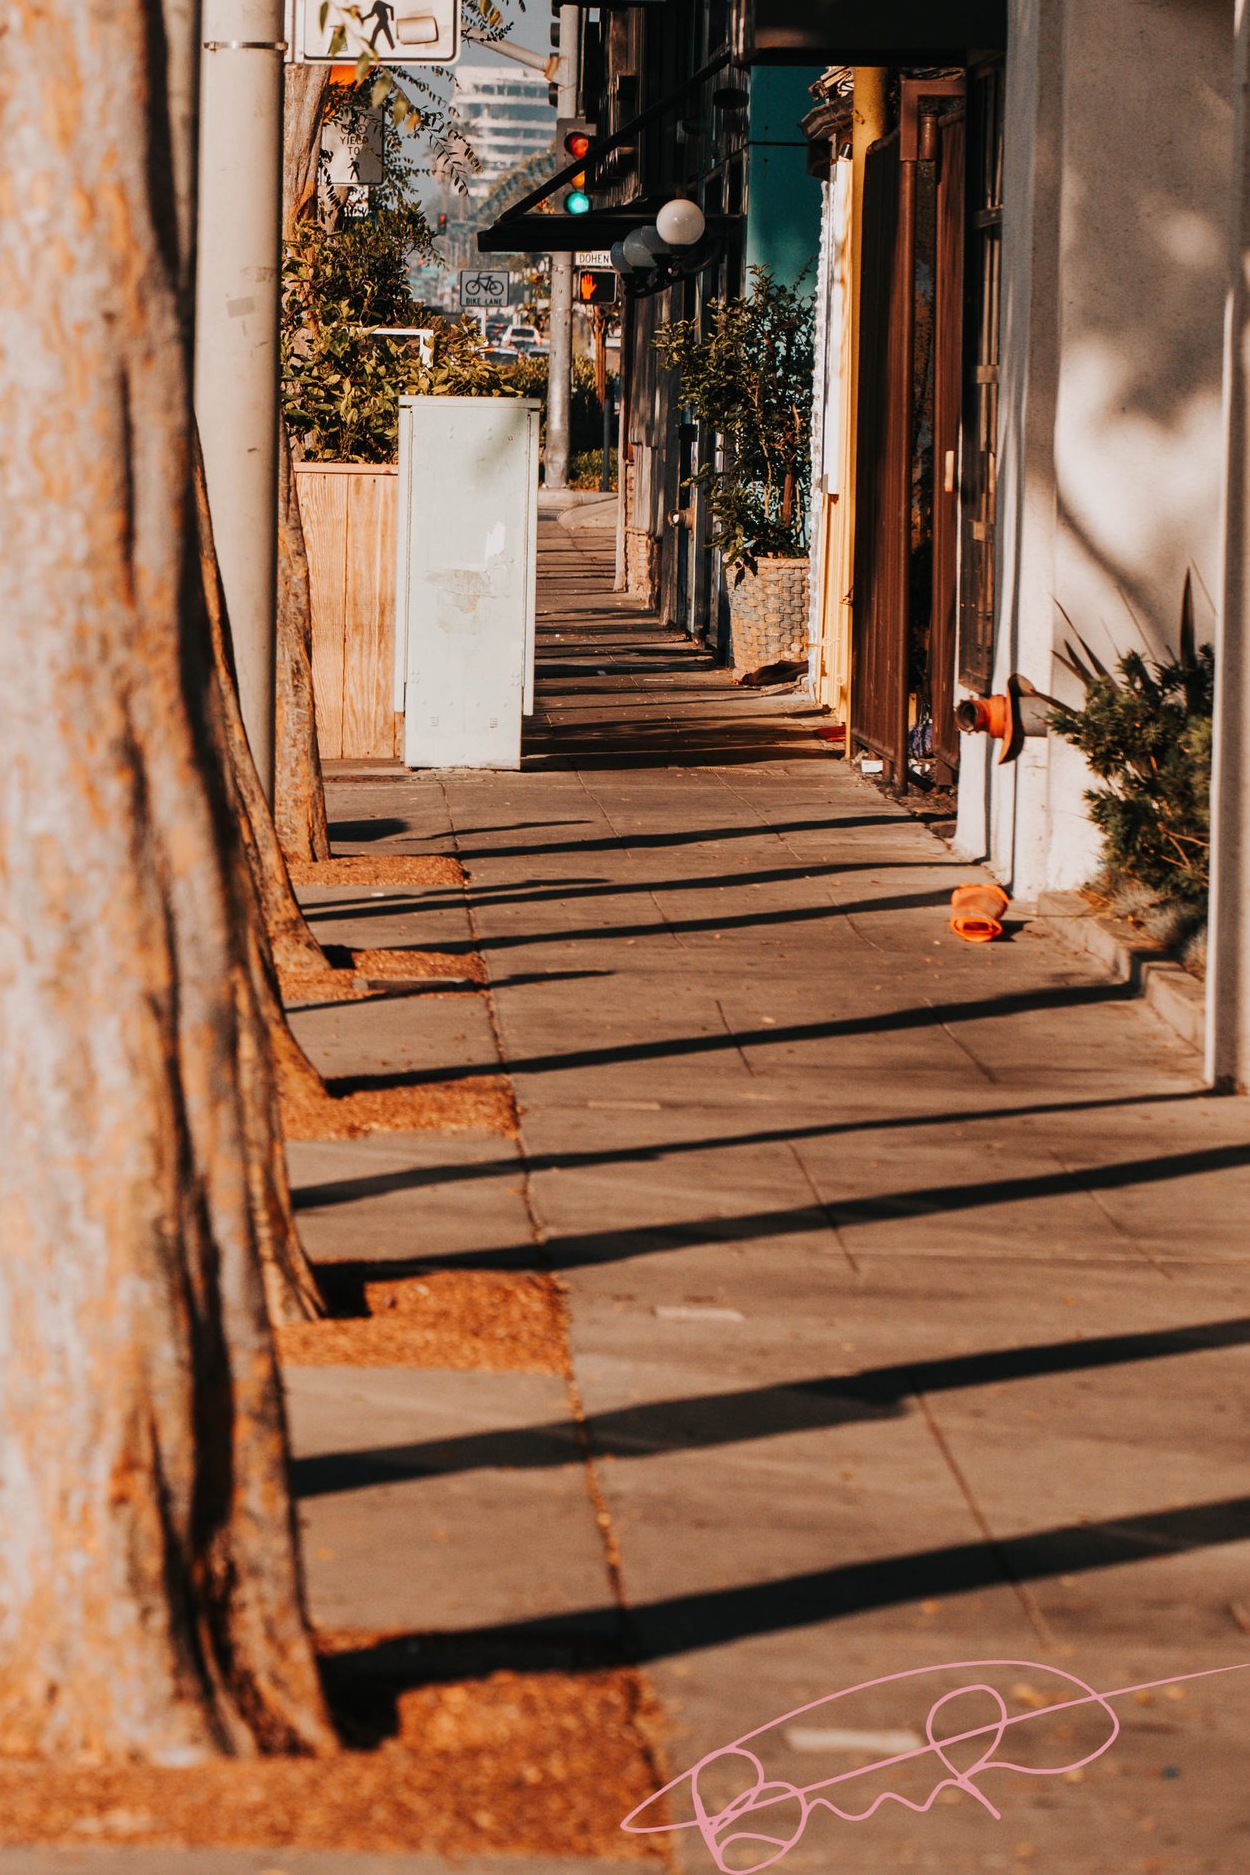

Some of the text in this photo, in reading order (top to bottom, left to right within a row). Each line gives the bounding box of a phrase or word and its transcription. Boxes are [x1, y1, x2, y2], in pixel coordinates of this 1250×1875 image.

[348, 146, 361, 156] TO
[579, 254, 610, 264] DOHEN
[466, 297, 503, 305] BIKE LANE
